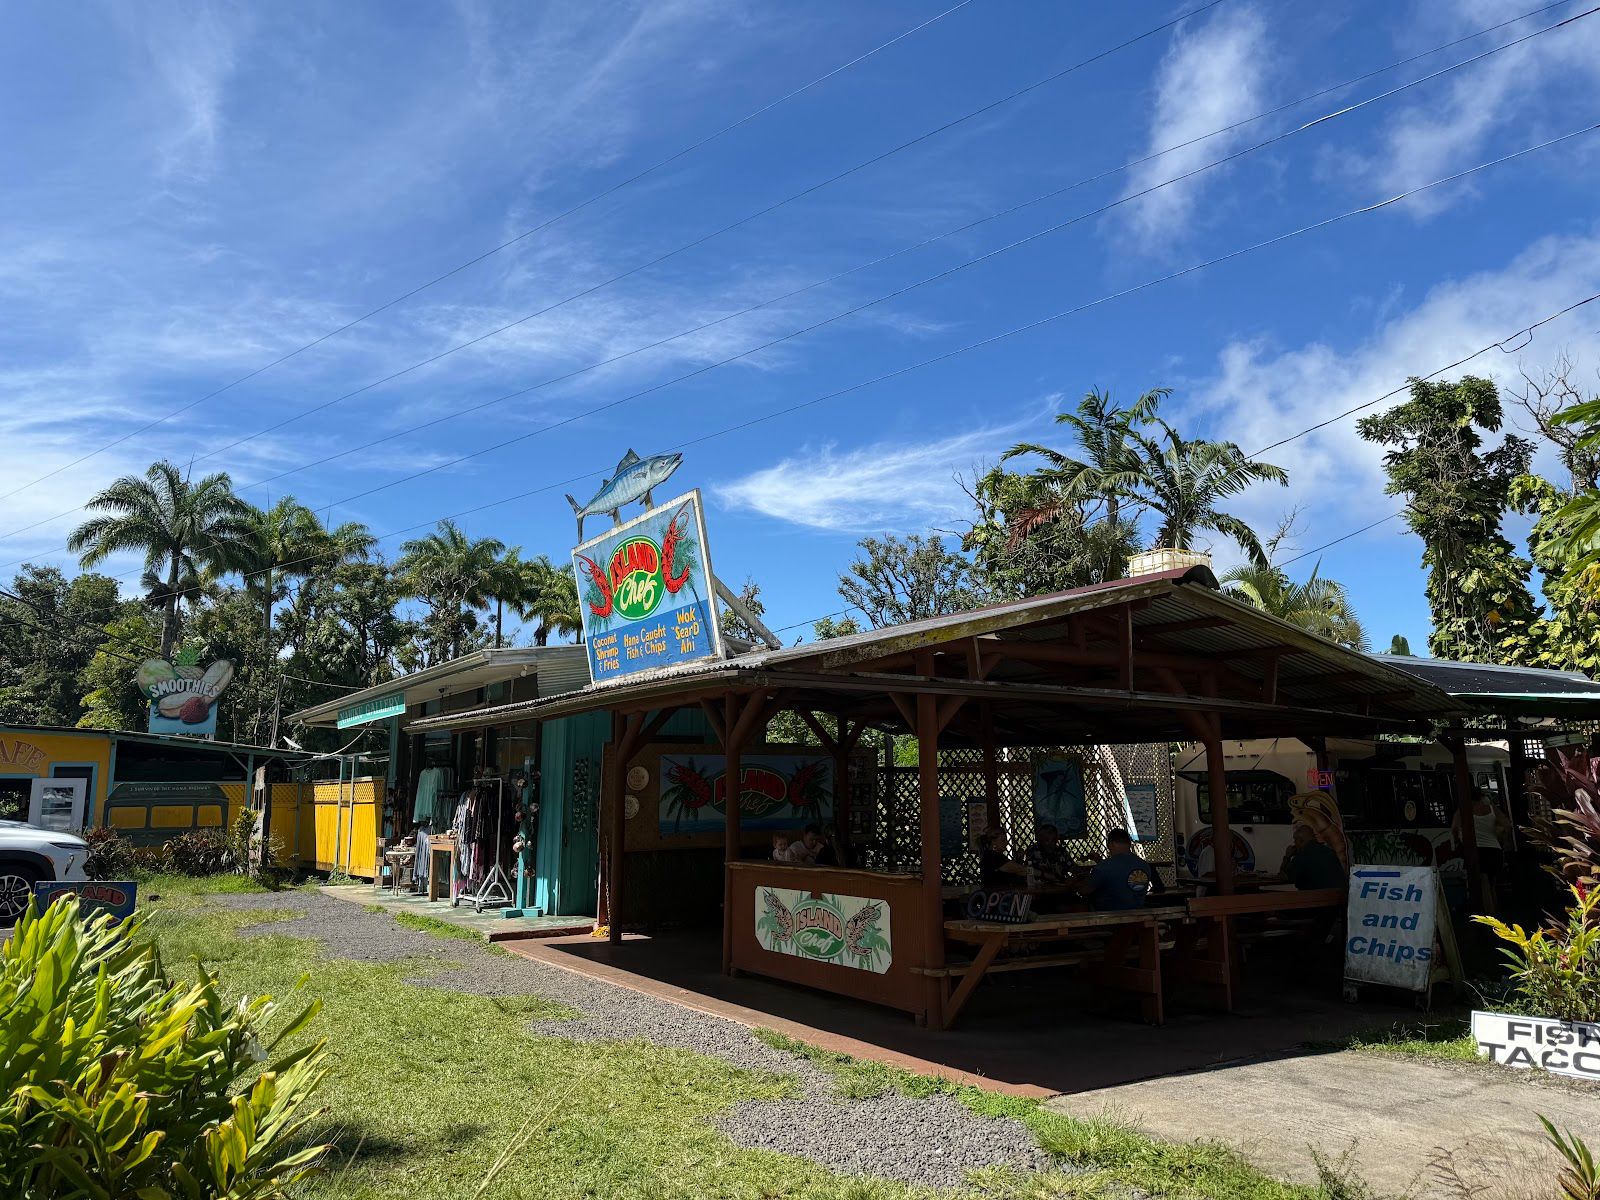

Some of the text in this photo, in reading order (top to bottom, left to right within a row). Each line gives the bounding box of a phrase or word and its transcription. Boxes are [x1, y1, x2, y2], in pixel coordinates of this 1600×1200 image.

[610, 542, 658, 594] ISLAND
[620, 572, 657, 611] Chef
[593, 633, 617, 649] Coconut
[641, 624, 666, 642] Caught
[596, 647, 619, 660] Shrimp
[626, 647, 639, 660] Fish
[644, 640, 666, 655] Chips
[680, 636, 695, 654] Ahi
[603, 659, 620, 672] Fries
[149, 679, 221, 698] SMOOTHIES
[1360, 881, 1423, 902] Fish
[967, 890, 1029, 918] OPEN
[795, 906, 843, 940] ISLAND
[1362, 912, 1420, 930] and
[800, 932, 835, 954] Chef
[1347, 936, 1432, 963] Chips
